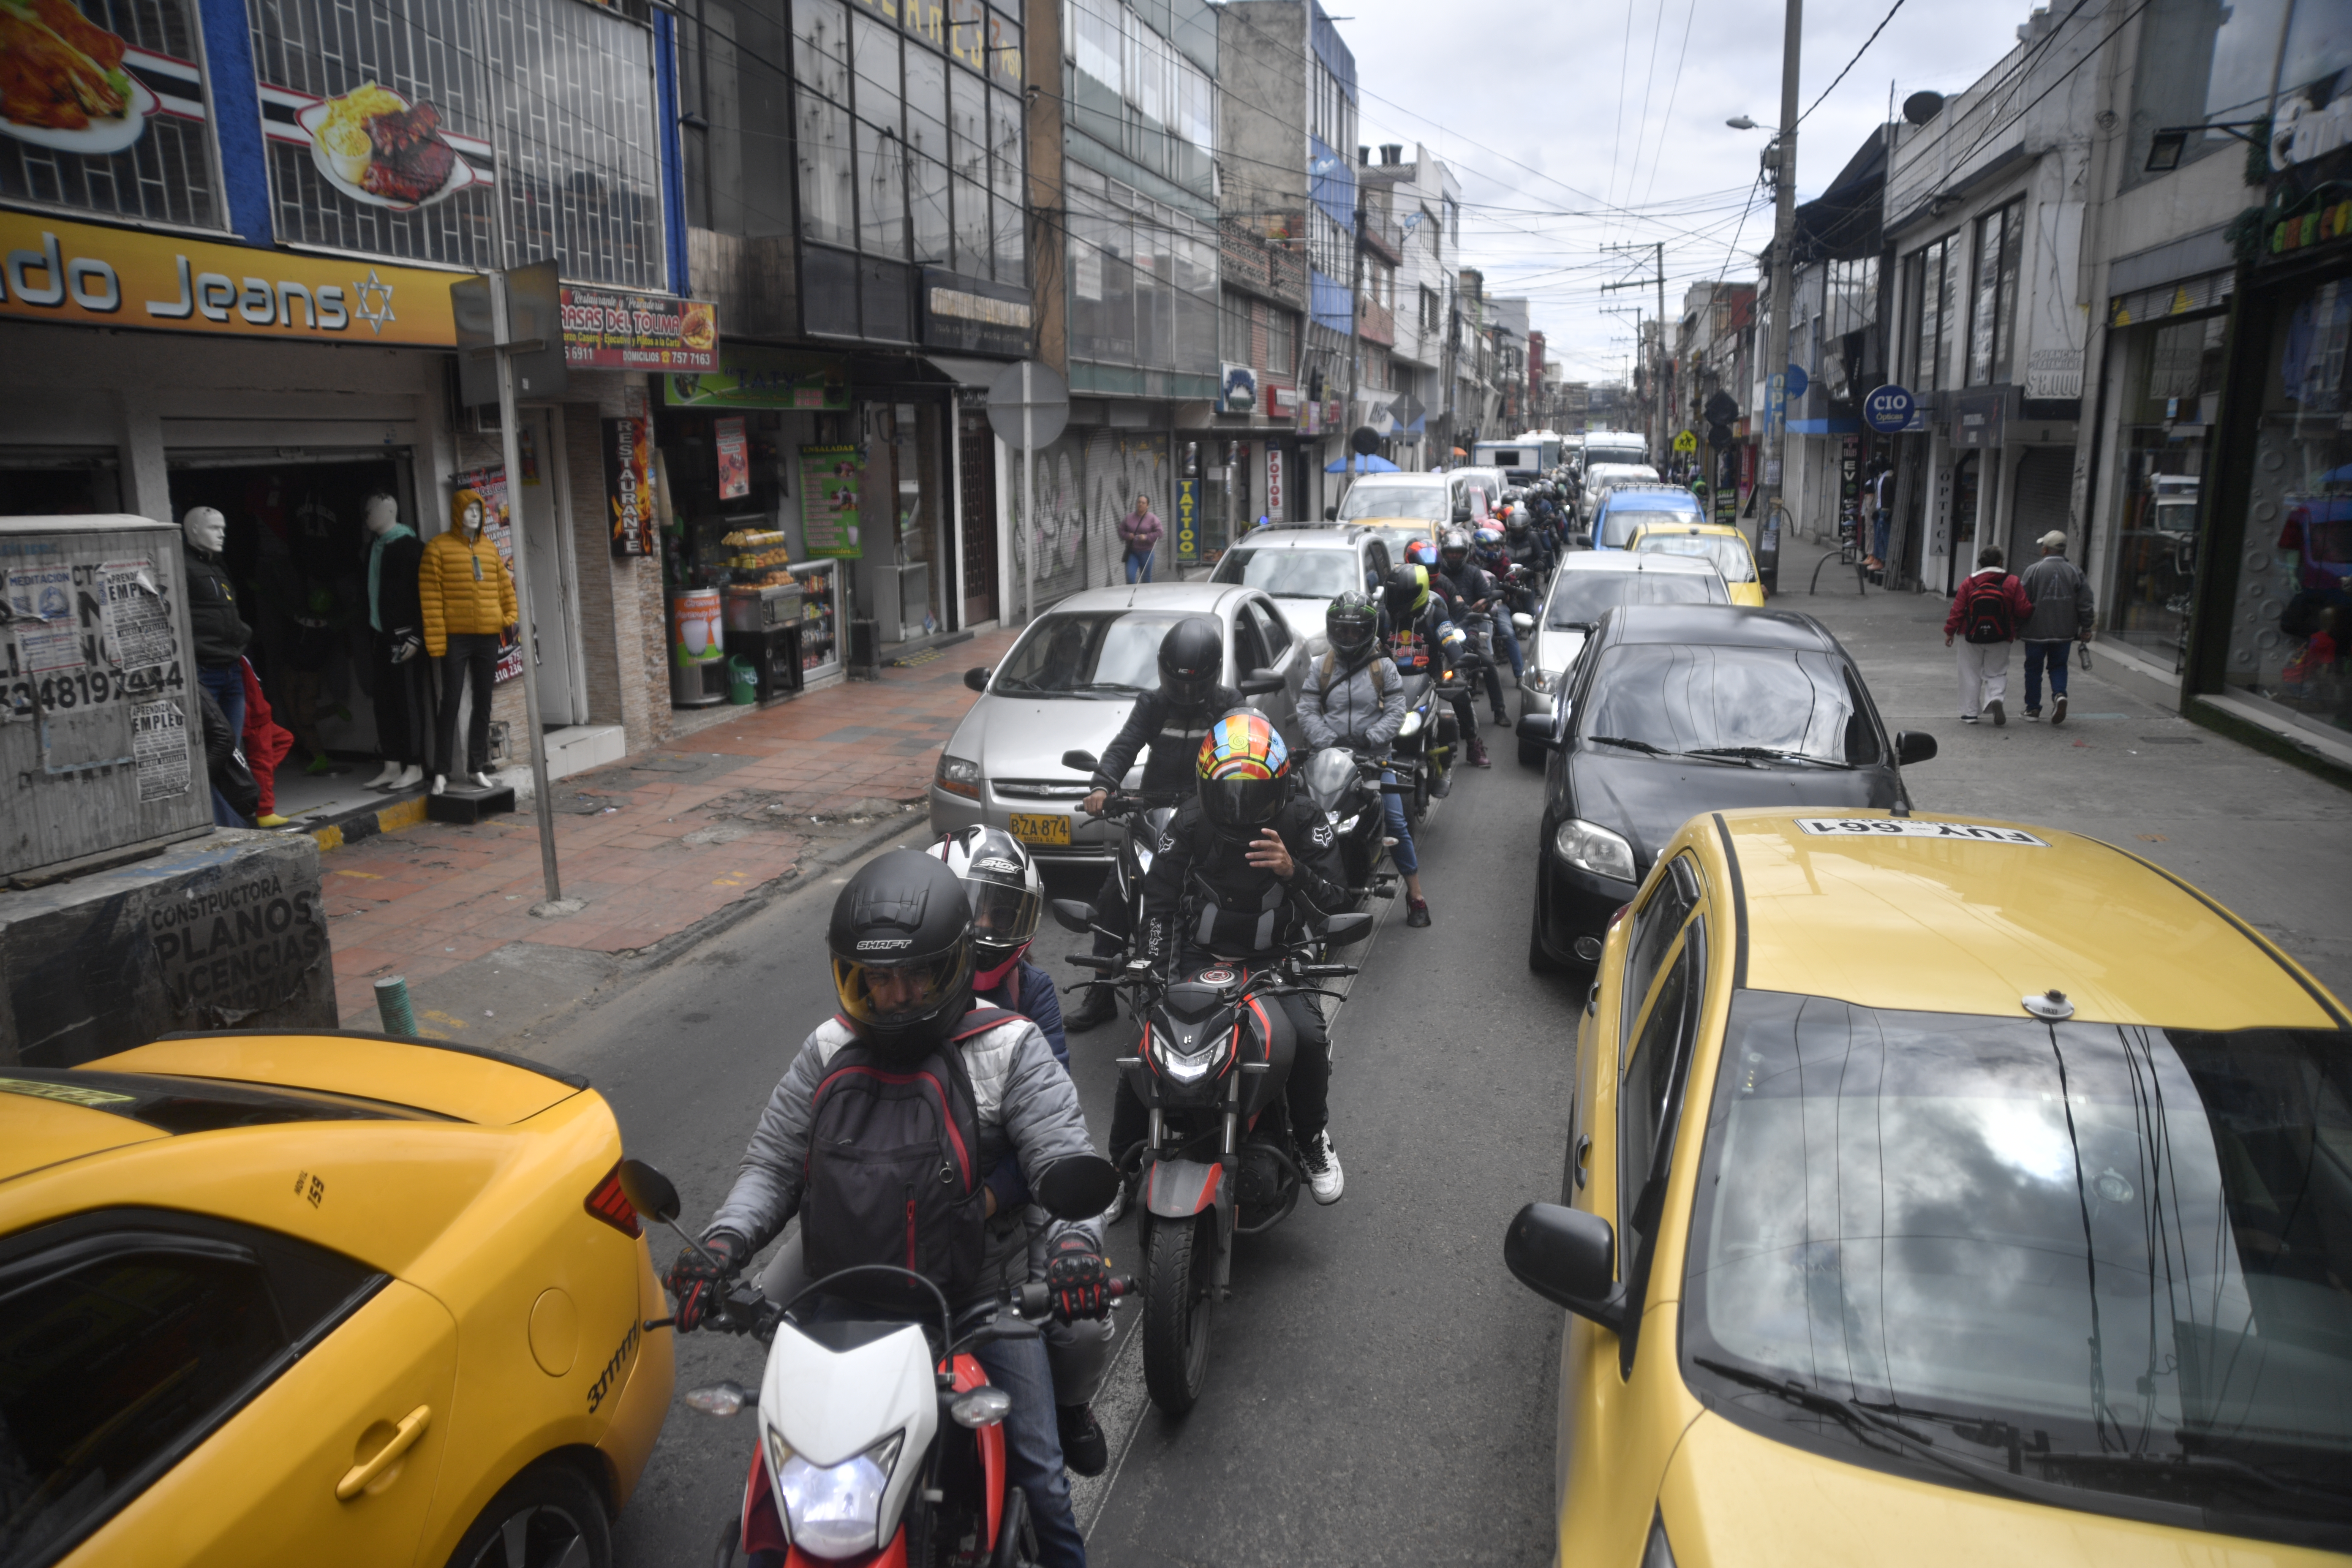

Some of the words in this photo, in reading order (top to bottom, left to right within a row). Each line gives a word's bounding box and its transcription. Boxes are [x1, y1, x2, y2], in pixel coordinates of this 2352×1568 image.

[1002, 40, 1021, 80] PISO
[145, 255, 348, 329] Jeans
[572, 289, 616, 306] Restaurante
[619, 299, 623, 309] y
[606, 308, 631, 333] DEL
[633, 312, 680, 335] TOLIMA
[578, 332, 599, 343] Casero
[604, 334, 630, 345] Ejecutivo
[637, 335, 653, 346] Platos
[659, 337, 664, 346] la
[666, 338, 680, 347] Carta
[572, 347, 592, 360] 6911
[623, 351, 659, 362] DOMICILIOS
[672, 351, 687, 364] 757
[690, 353, 710, 365] 7163
[2039, 349, 2081, 359] PLANCHA
[2033, 359, 2082, 370] TRATAMIENTO
[1874, 395, 1907, 410] CIO
[1876, 413, 1903, 421] Ópticas
[617, 421, 640, 552] RESTAURANTE
[1270, 452, 1279, 506] FOTOS
[1717, 489, 1735, 498] SALE
[1179, 481, 1194, 552] TATTOO
[1936, 470, 1950, 553] ÓPTICA
[9, 572, 69, 586] MEDITACION
[1406, 644, 1428, 656] Bull
[509, 662, 523, 675] 236
[1041, 819, 1067, 837] 874
[1812, 822, 1903, 833] 661
[1938, 826, 2036, 843] FUY
[979, 859, 1017, 872] SHOX
[151, 876, 282, 930] CONSTRUCTORA
[155, 890, 313, 970] PLANOS
[856, 939, 912, 950] SHAFT
[294, 1170, 308, 1196] MOVIL
[307, 1175, 324, 1209] 159
